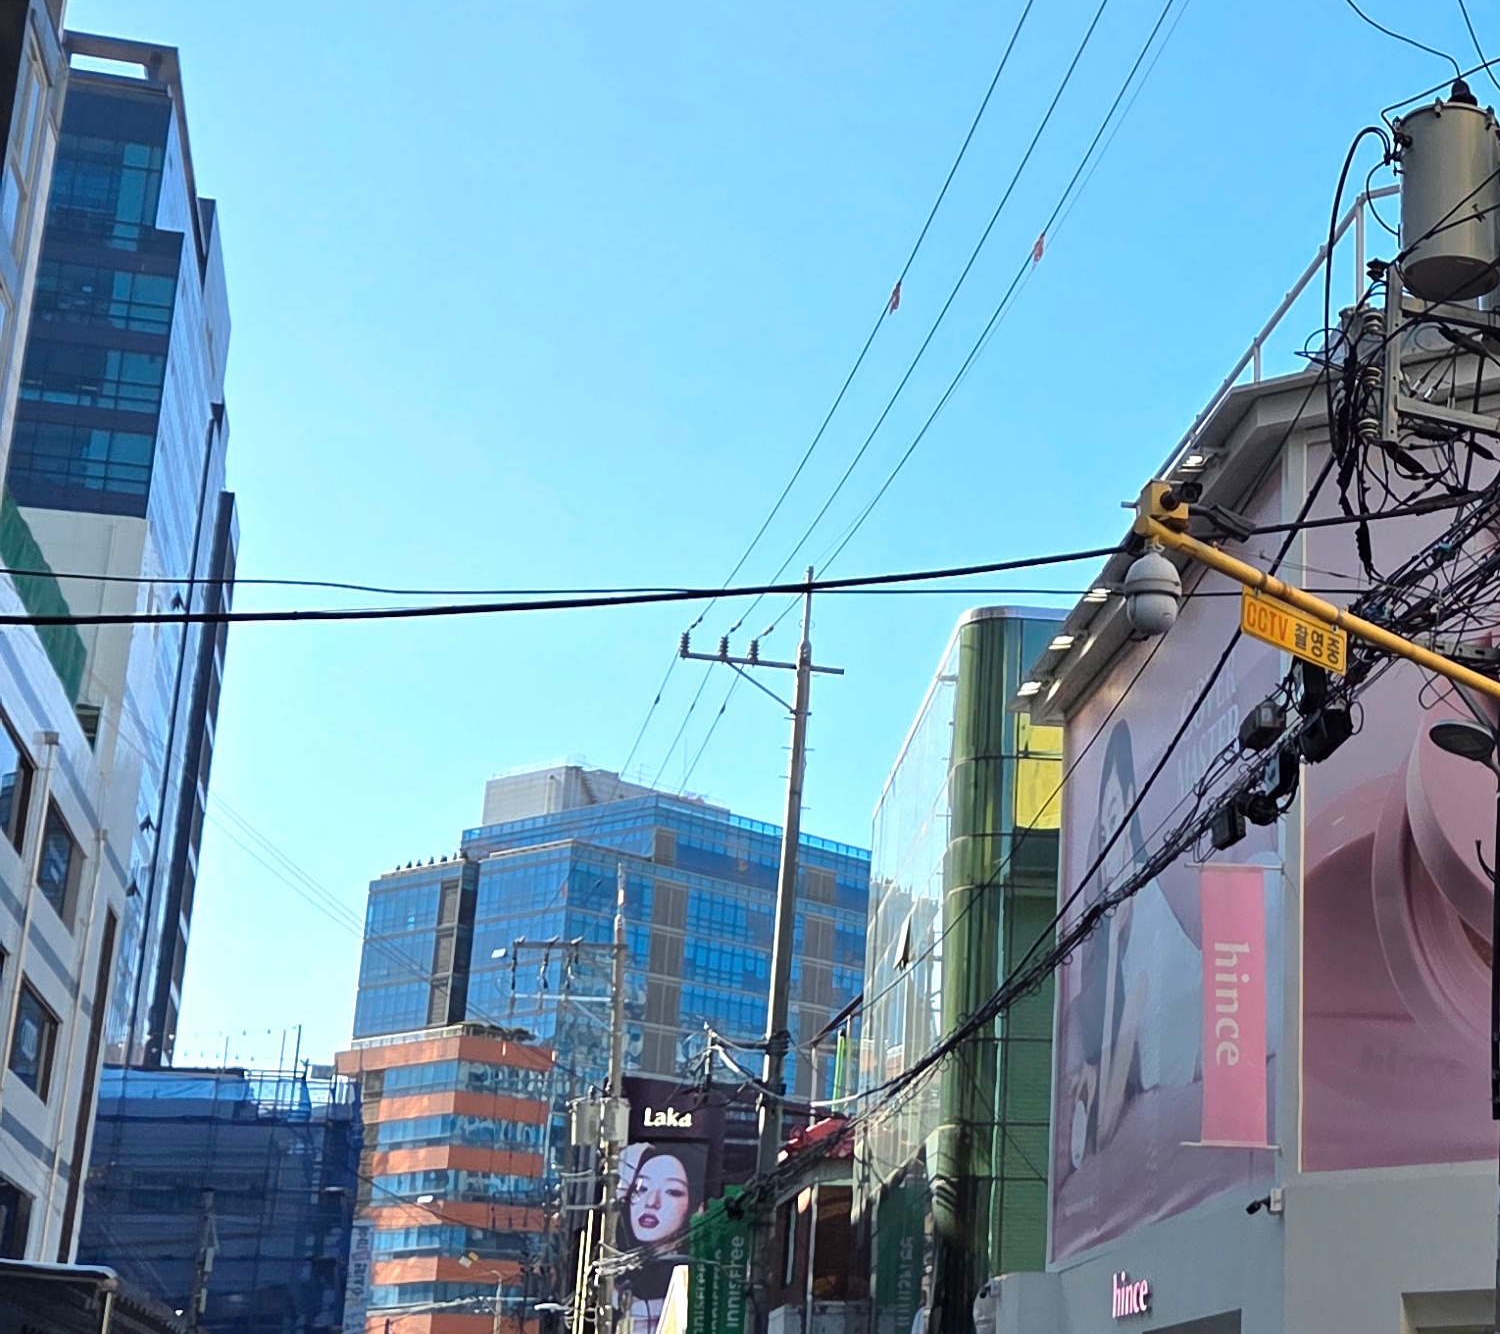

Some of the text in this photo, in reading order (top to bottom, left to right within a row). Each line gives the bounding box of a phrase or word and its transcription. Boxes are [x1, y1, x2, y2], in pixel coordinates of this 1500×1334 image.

[1246, 601, 1340, 665] CCTV 촬영중
[1214, 942, 1250, 1066] hince
[643, 1107, 693, 1127] Laka
[1112, 1270, 1148, 1319] hince
